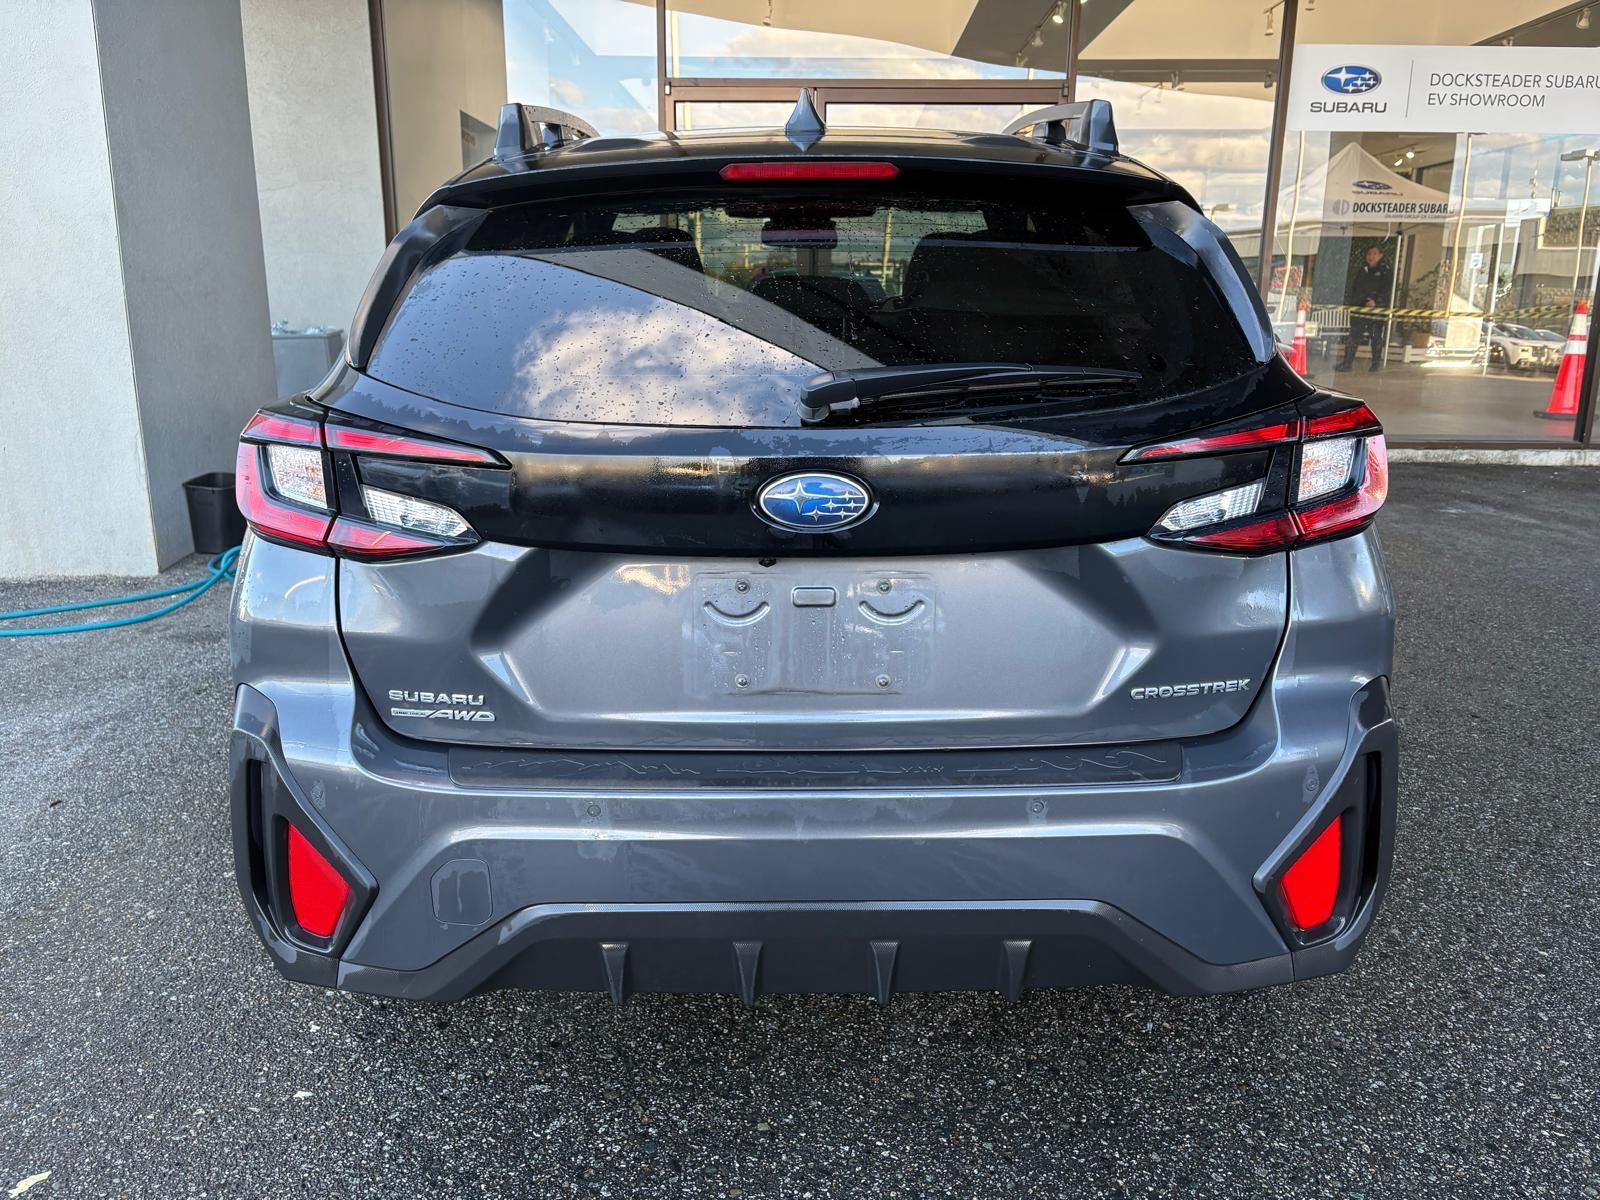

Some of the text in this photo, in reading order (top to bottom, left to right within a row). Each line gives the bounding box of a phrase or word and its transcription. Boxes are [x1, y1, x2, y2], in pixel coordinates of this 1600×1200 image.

[1430, 73, 1541, 88] DOCKSTEADER
[1427, 93, 1545, 107] EV SHOWROOM
[1310, 102, 1388, 113] SUBARU
[1353, 202, 1416, 214] DOCKSTEADER
[1130, 678, 1252, 700] CROSSTREK
[389, 689, 484, 706] SUBARU
[429, 709, 496, 722] AWD
